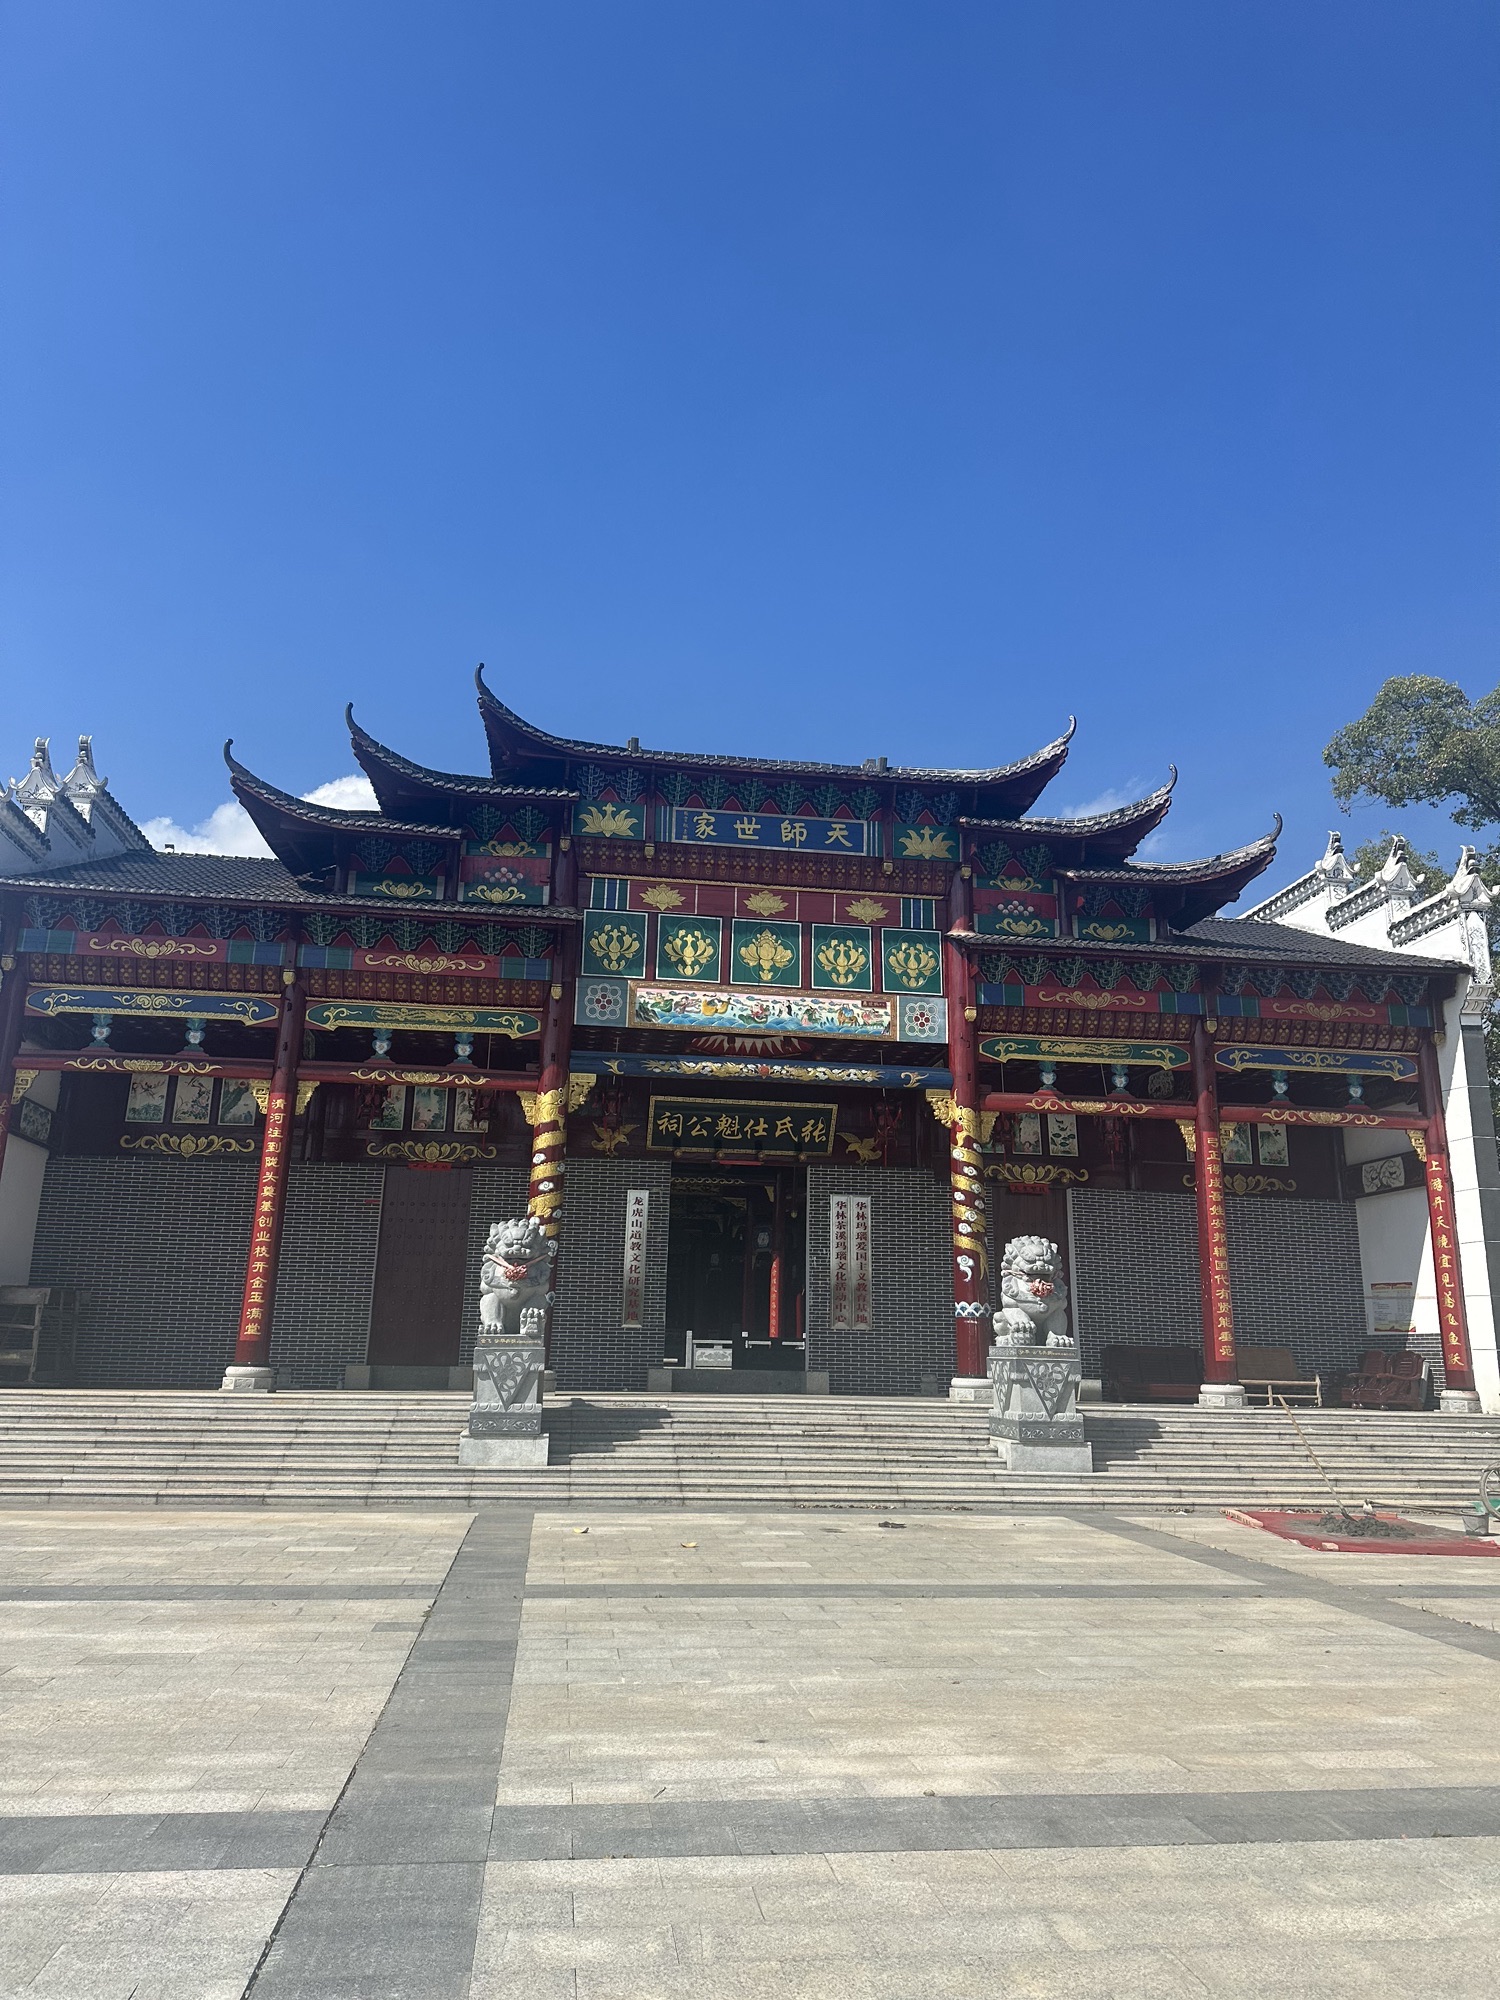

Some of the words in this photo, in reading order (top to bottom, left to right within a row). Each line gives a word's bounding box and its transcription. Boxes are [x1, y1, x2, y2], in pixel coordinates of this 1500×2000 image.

[692, 812, 853, 848] 天師世家
[626, 1196, 644, 1321] 龙虎山道教文化研究基地
[835, 1200, 847, 1323] 华林茶溪玛瑙文化活动中心
[855, 1201, 868, 1324] 华林玛瑙爱国主义教育基地
